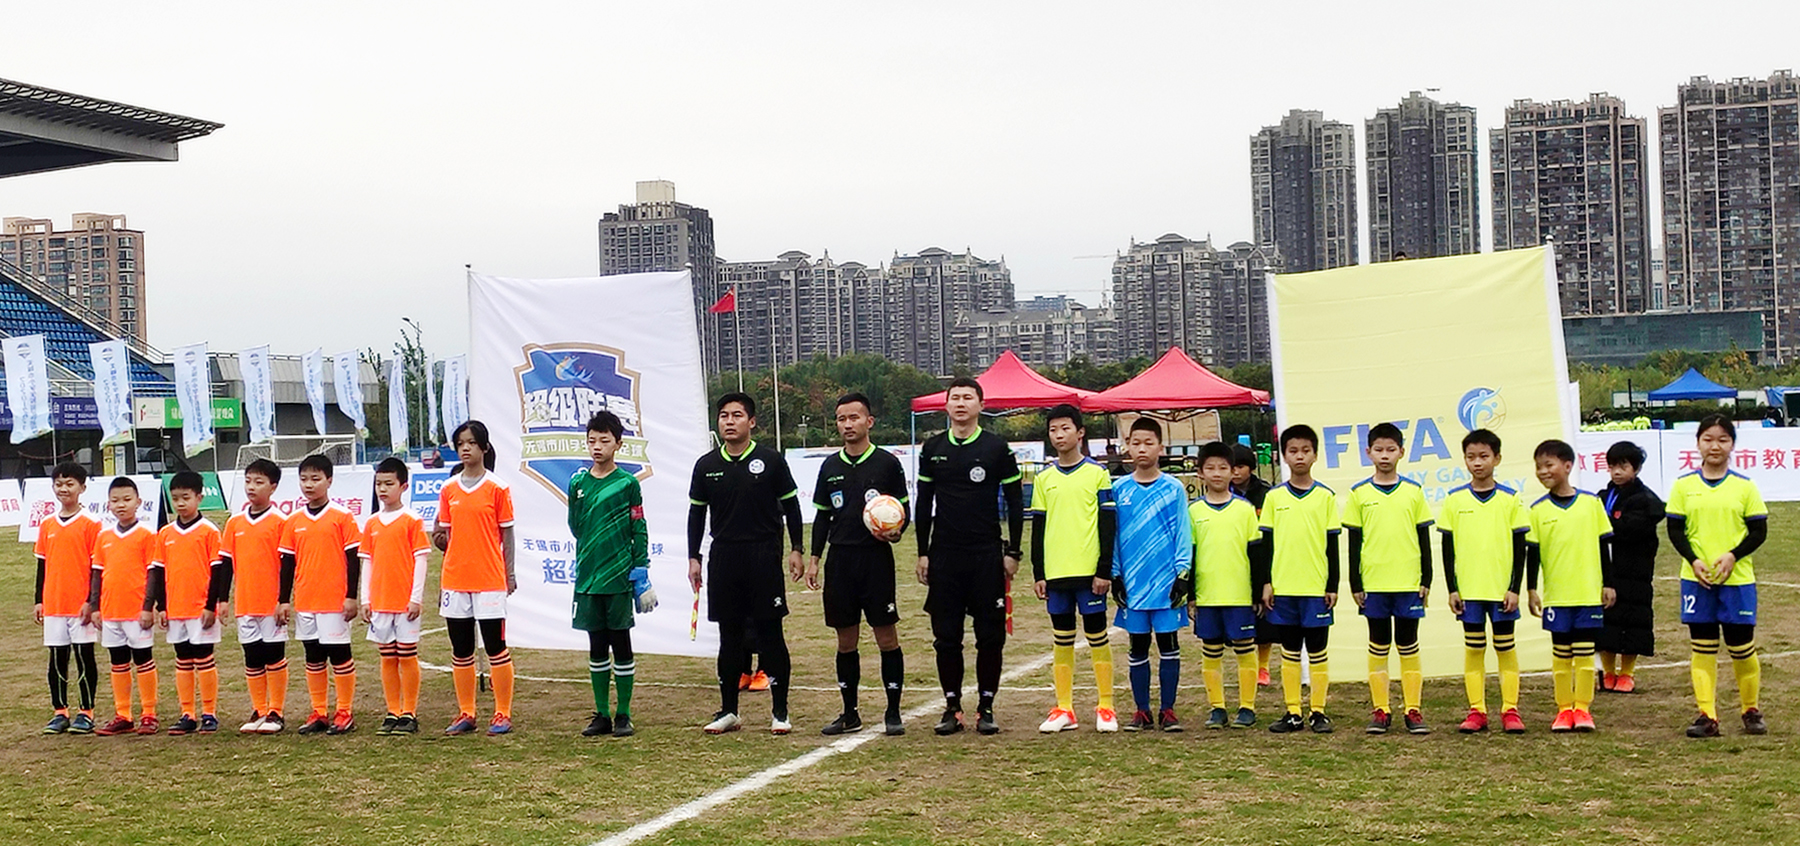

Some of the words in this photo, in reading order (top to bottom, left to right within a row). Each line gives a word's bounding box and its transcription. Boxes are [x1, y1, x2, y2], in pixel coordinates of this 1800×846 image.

[525, 438, 643, 457] 无锡市小学生足球
[1678, 448, 1800, 470] 无市教
[1683, 594, 1696, 613] 12
